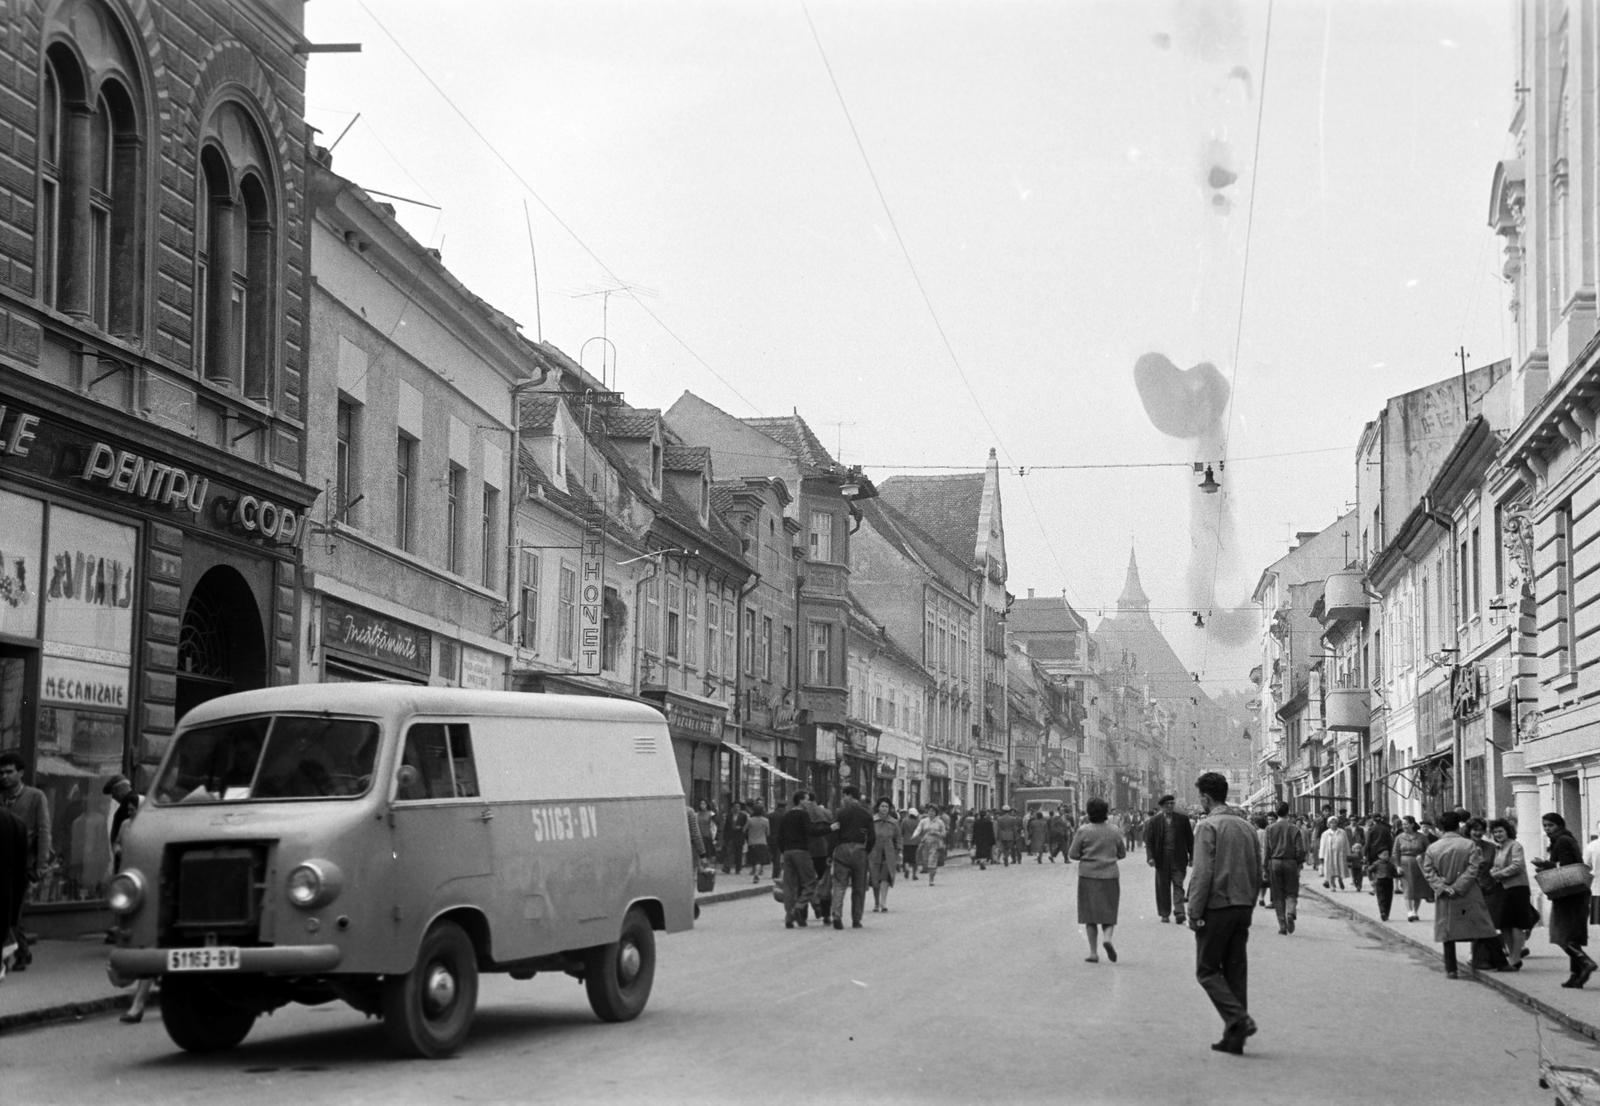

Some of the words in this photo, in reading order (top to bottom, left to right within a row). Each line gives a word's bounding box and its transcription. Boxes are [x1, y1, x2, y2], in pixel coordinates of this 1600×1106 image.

[82, 441, 209, 514] PENTRU
[45, 676, 123, 706] MECANIZATE
[172, 949, 237, 969] 51163-BV
